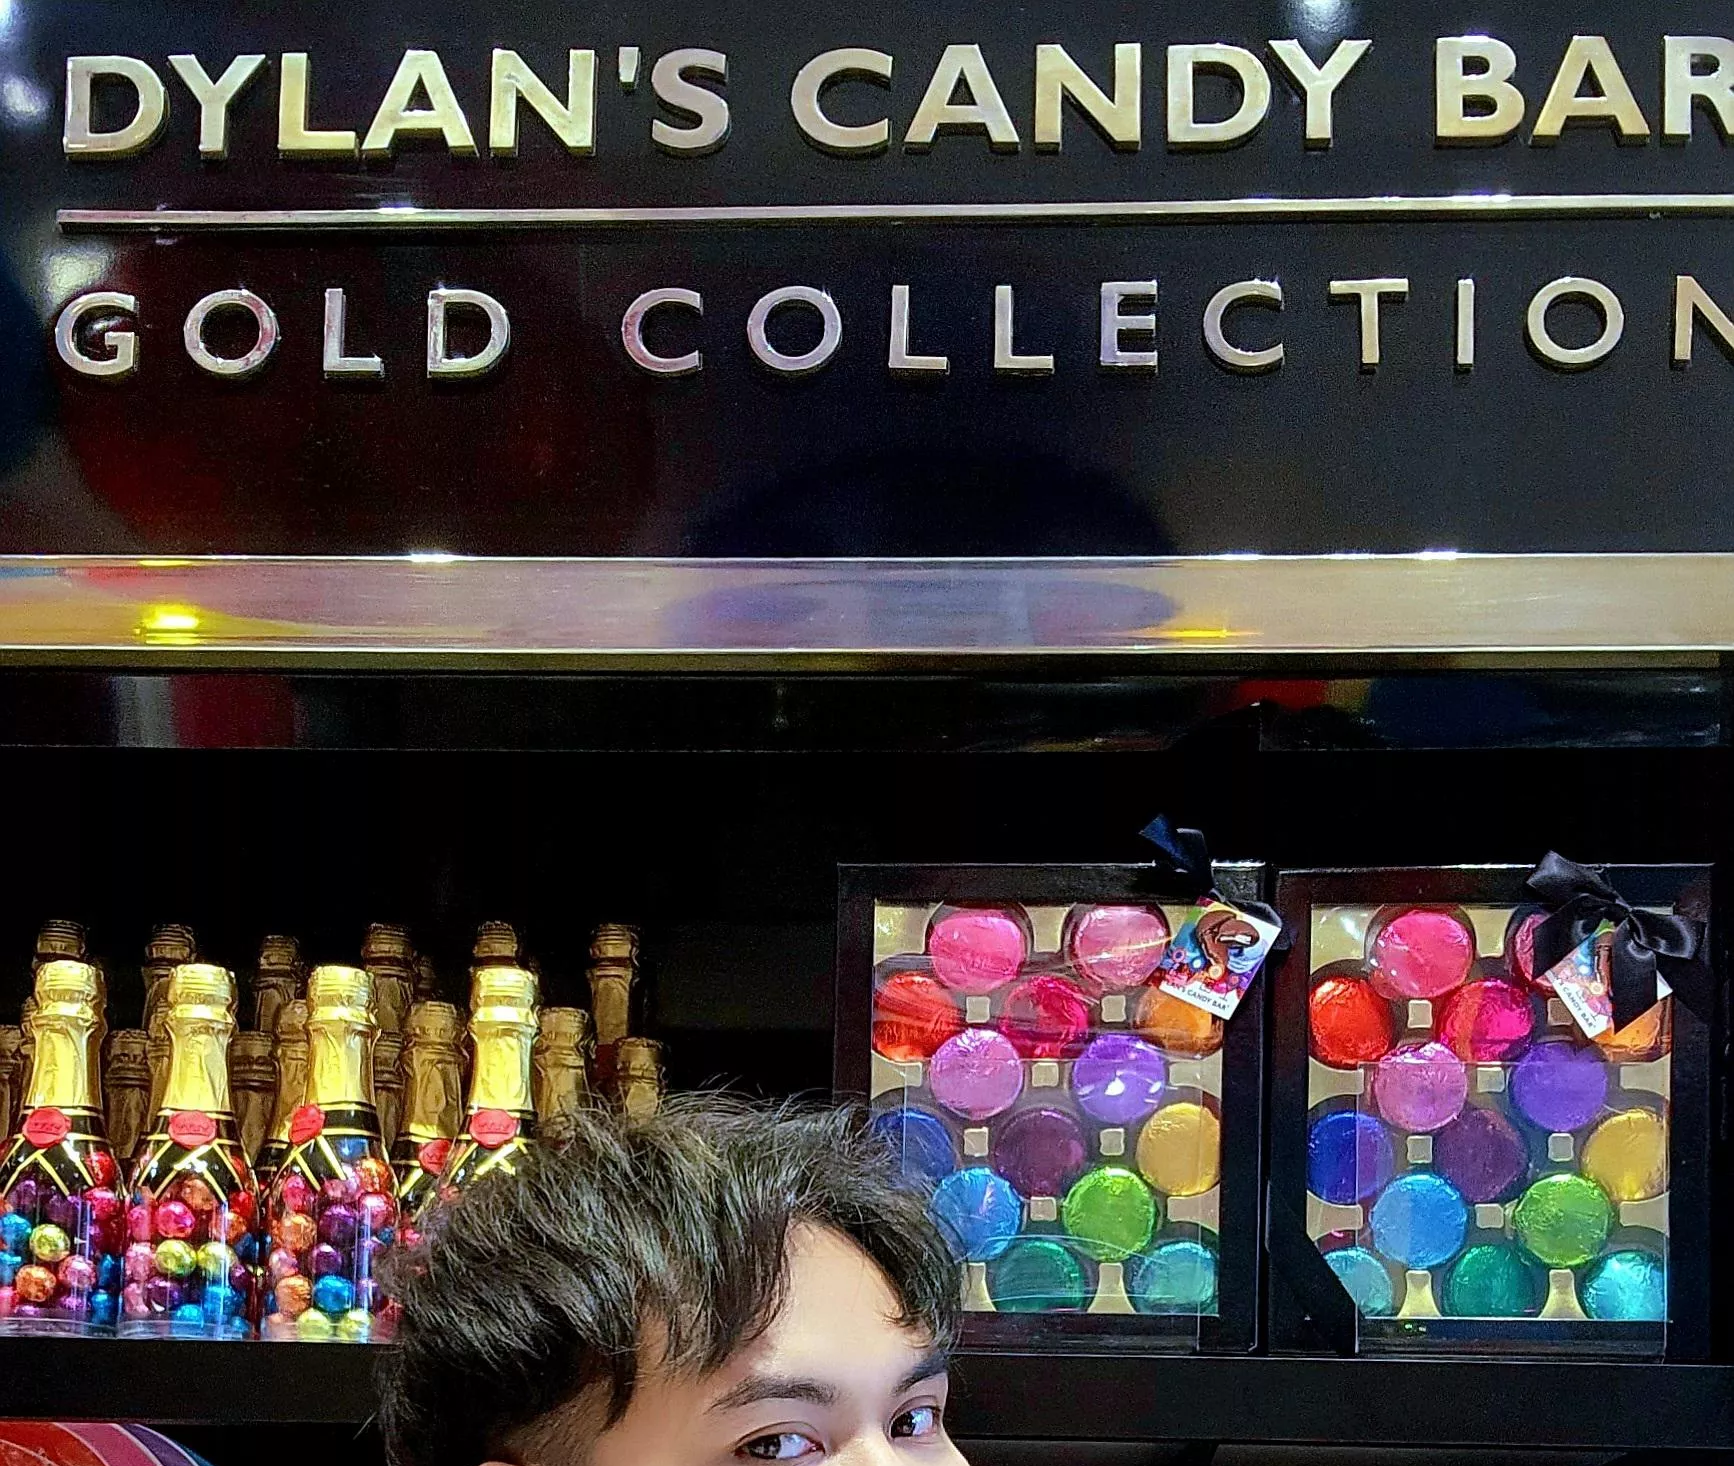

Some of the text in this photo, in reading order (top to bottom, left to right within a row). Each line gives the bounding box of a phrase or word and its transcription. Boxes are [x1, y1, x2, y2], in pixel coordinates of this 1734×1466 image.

[62, 34, 1734, 160] DYLAN'S CANDY BAR
[54, 276, 1734, 380] GOLD COLLECTION
[1187, 987, 1213, 1003] CANDY
[1211, 1000, 1227, 1010] BAR
[1563, 987, 1581, 1011] CANDY
